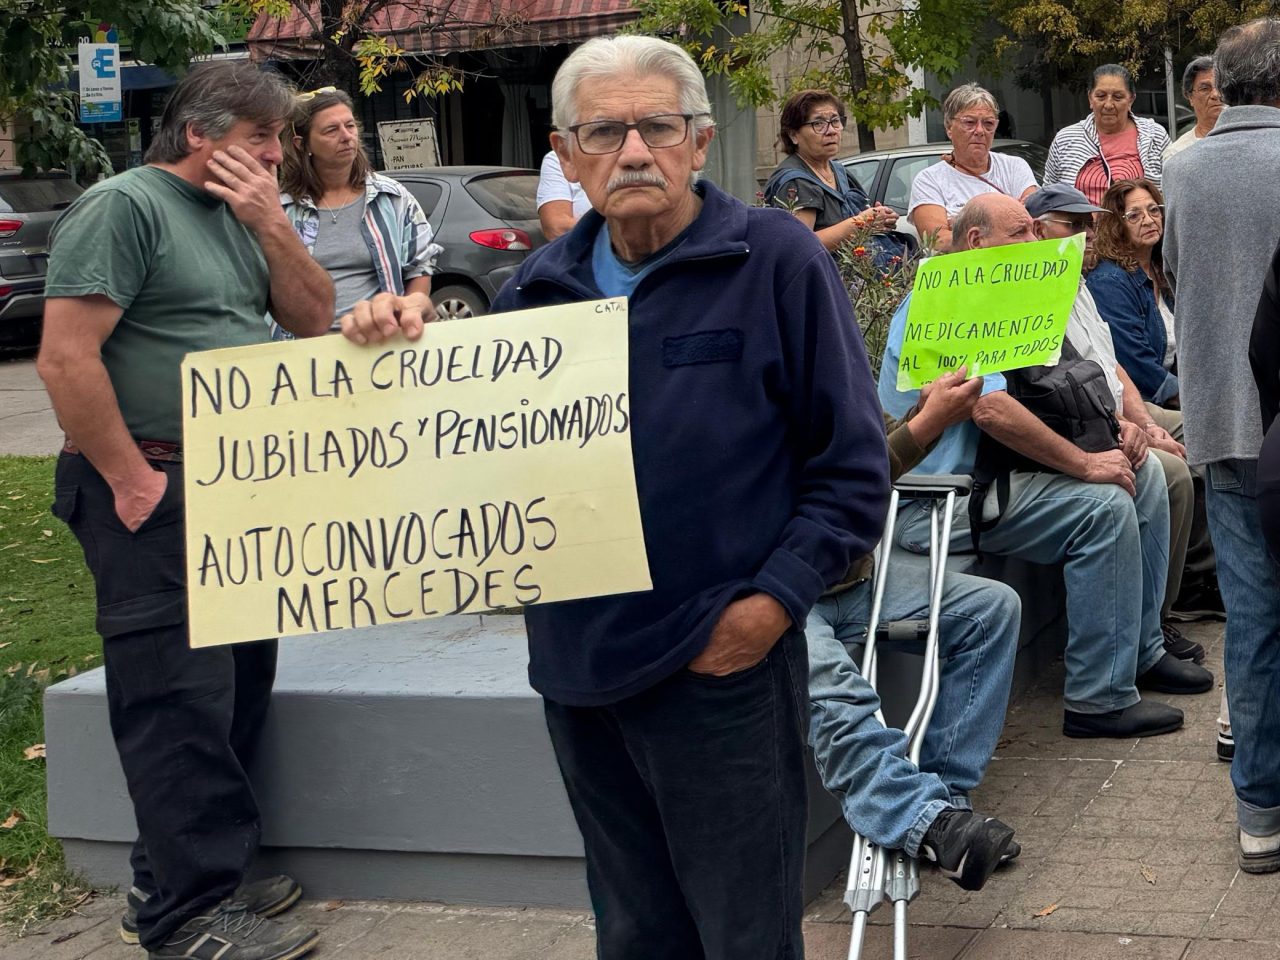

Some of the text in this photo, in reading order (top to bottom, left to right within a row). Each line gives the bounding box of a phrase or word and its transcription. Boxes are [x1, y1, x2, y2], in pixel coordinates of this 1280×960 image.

[918, 260, 1069, 291] NO A LA CRUELDAD
[902, 354, 921, 372] AL
[975, 349, 1006, 366] PARA
[1014, 334, 1061, 357] TODOS
[905, 313, 1054, 343] MEDICAMENTOS
[191, 336, 563, 418] NO A LA CRUELDAD
[196, 421, 408, 486] JUBILADOS
[435, 393, 629, 460] PENSIONADOS
[198, 497, 557, 588] AUTOCONVOCADOS
[277, 565, 542, 634] MERCEDES
